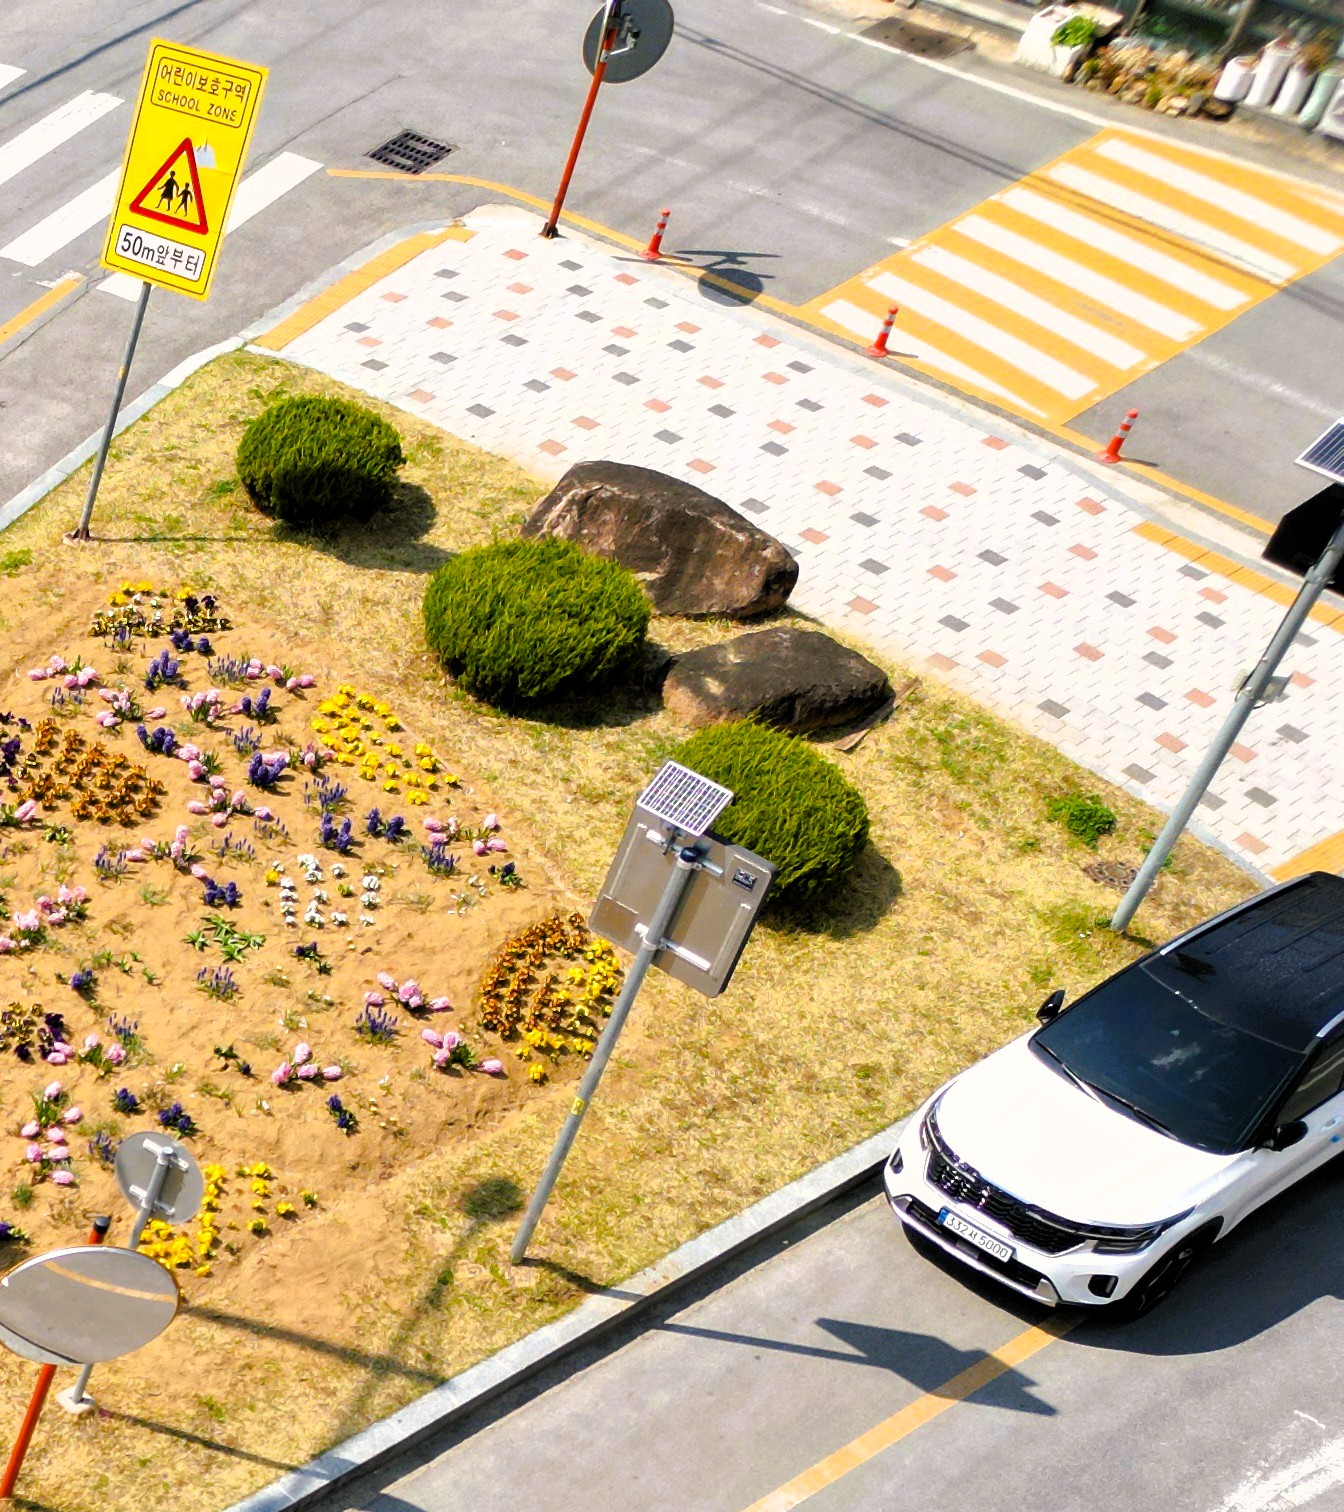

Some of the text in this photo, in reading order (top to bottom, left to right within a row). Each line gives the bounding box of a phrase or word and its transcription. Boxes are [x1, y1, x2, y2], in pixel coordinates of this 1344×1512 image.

[160, 63, 248, 104] 어린이보호구역
[158, 89, 237, 122] SCHOOL ZONE
[120, 231, 201, 276] 50m앞부터
[978, 1235, 1009, 1259] 5000
